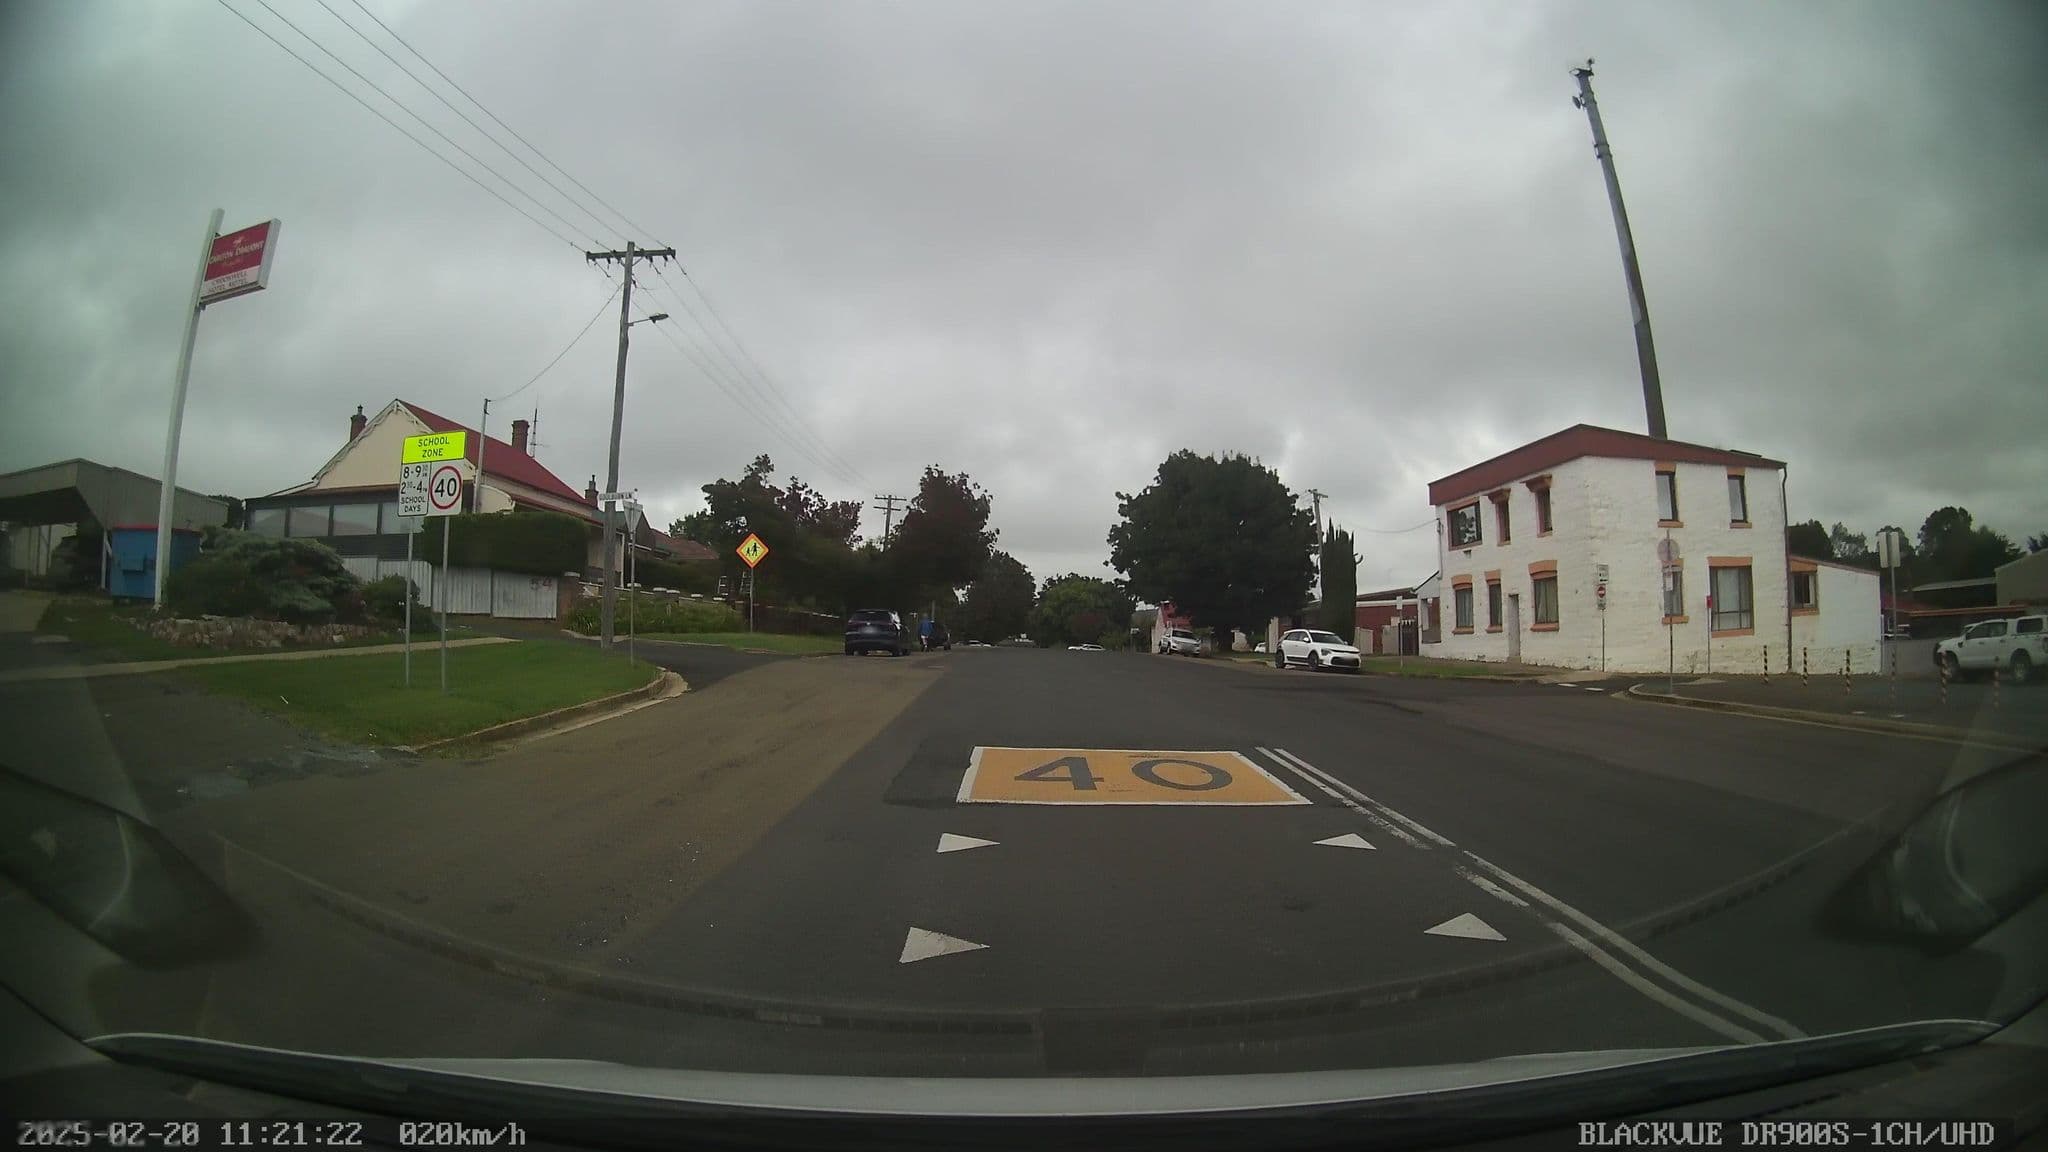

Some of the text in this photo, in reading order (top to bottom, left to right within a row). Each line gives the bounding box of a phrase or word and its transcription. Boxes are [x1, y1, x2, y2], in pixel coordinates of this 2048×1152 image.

[418, 436, 450, 447] SCHOOL
[422, 448, 444, 458] ZONE
[434, 477, 457, 498] 40
[400, 496, 425, 504] SCHOOL
[1014, 756, 1233, 791] 40
